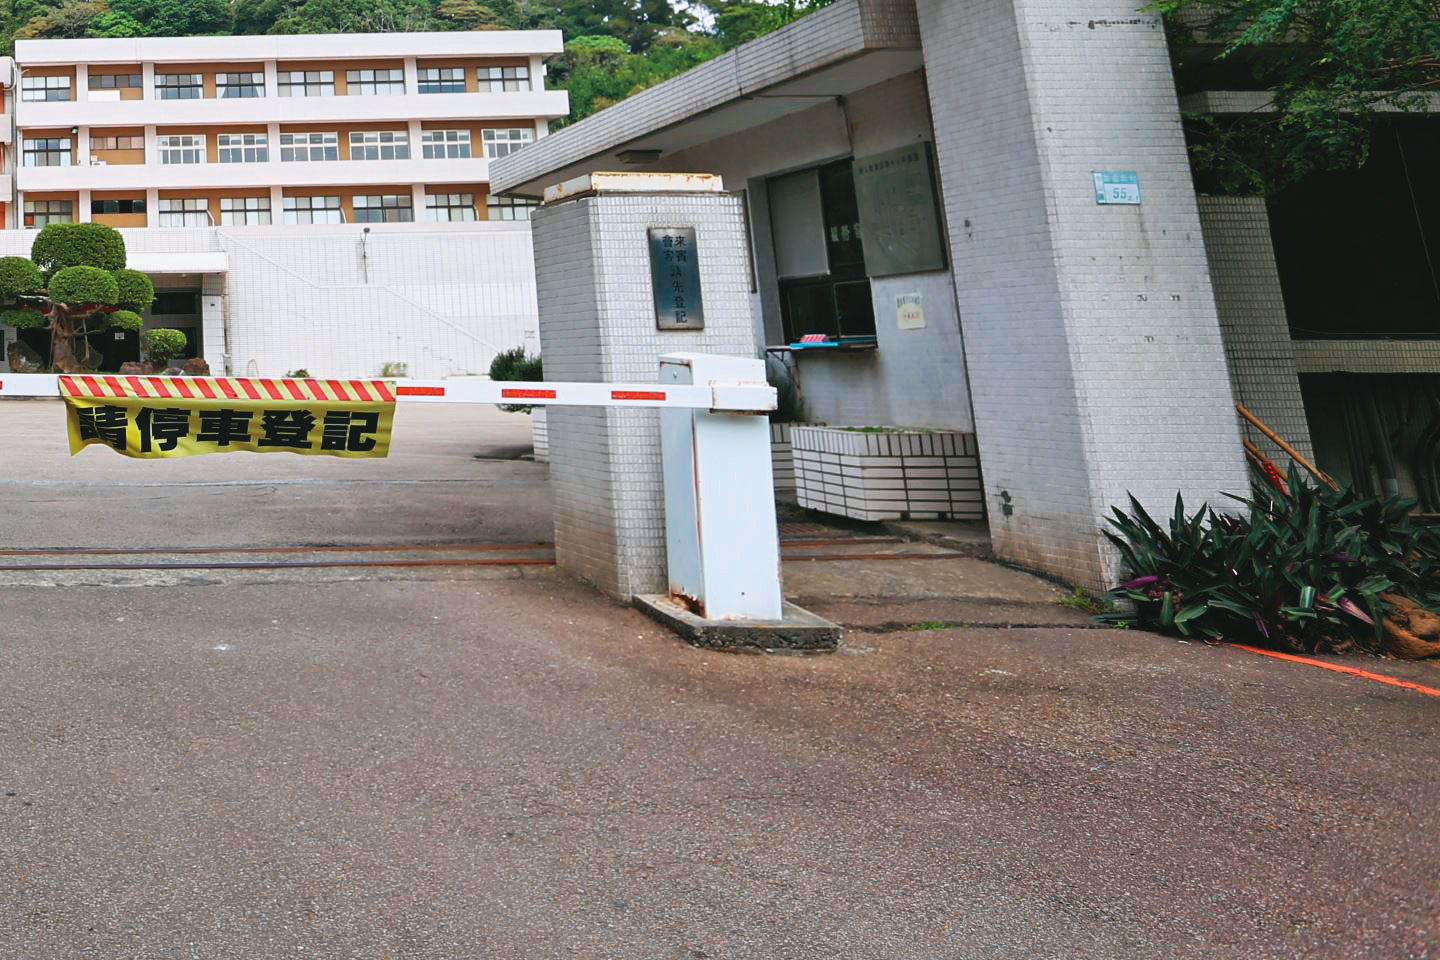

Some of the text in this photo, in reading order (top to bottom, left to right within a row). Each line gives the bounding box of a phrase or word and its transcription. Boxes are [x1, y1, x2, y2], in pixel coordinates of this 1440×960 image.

[76, 405, 379, 453] 請停車登記
